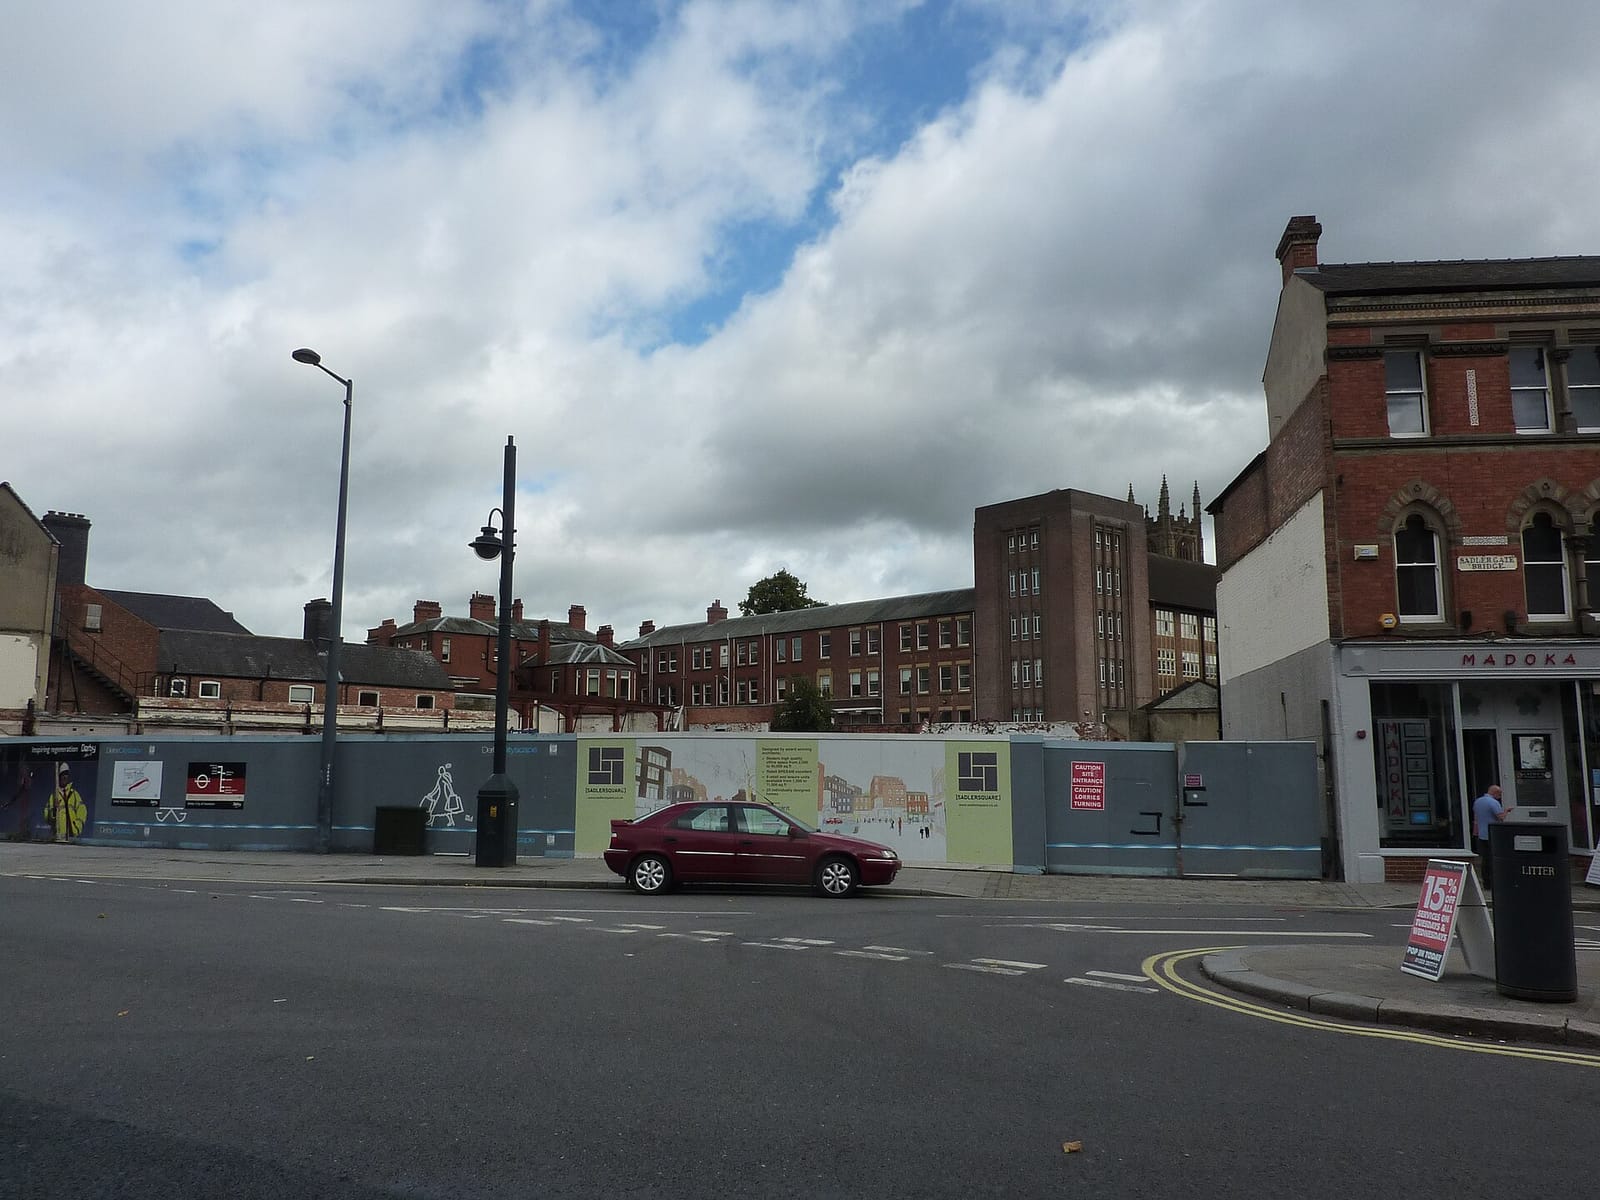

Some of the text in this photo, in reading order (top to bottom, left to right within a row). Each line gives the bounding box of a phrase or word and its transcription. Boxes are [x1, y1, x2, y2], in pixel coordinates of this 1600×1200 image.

[1462, 653, 1577, 666] MADOKA
[1522, 865, 1556, 876] LITTER
[1444, 895, 1457, 905] OFF
[1442, 904, 1453, 914] ALL
[1417, 910, 1441, 920] SERVICES
[1413, 927, 1448, 942] WEDNESDAYS
[1407, 946, 1419, 955] POP
[1425, 951, 1443, 962] TODAY
